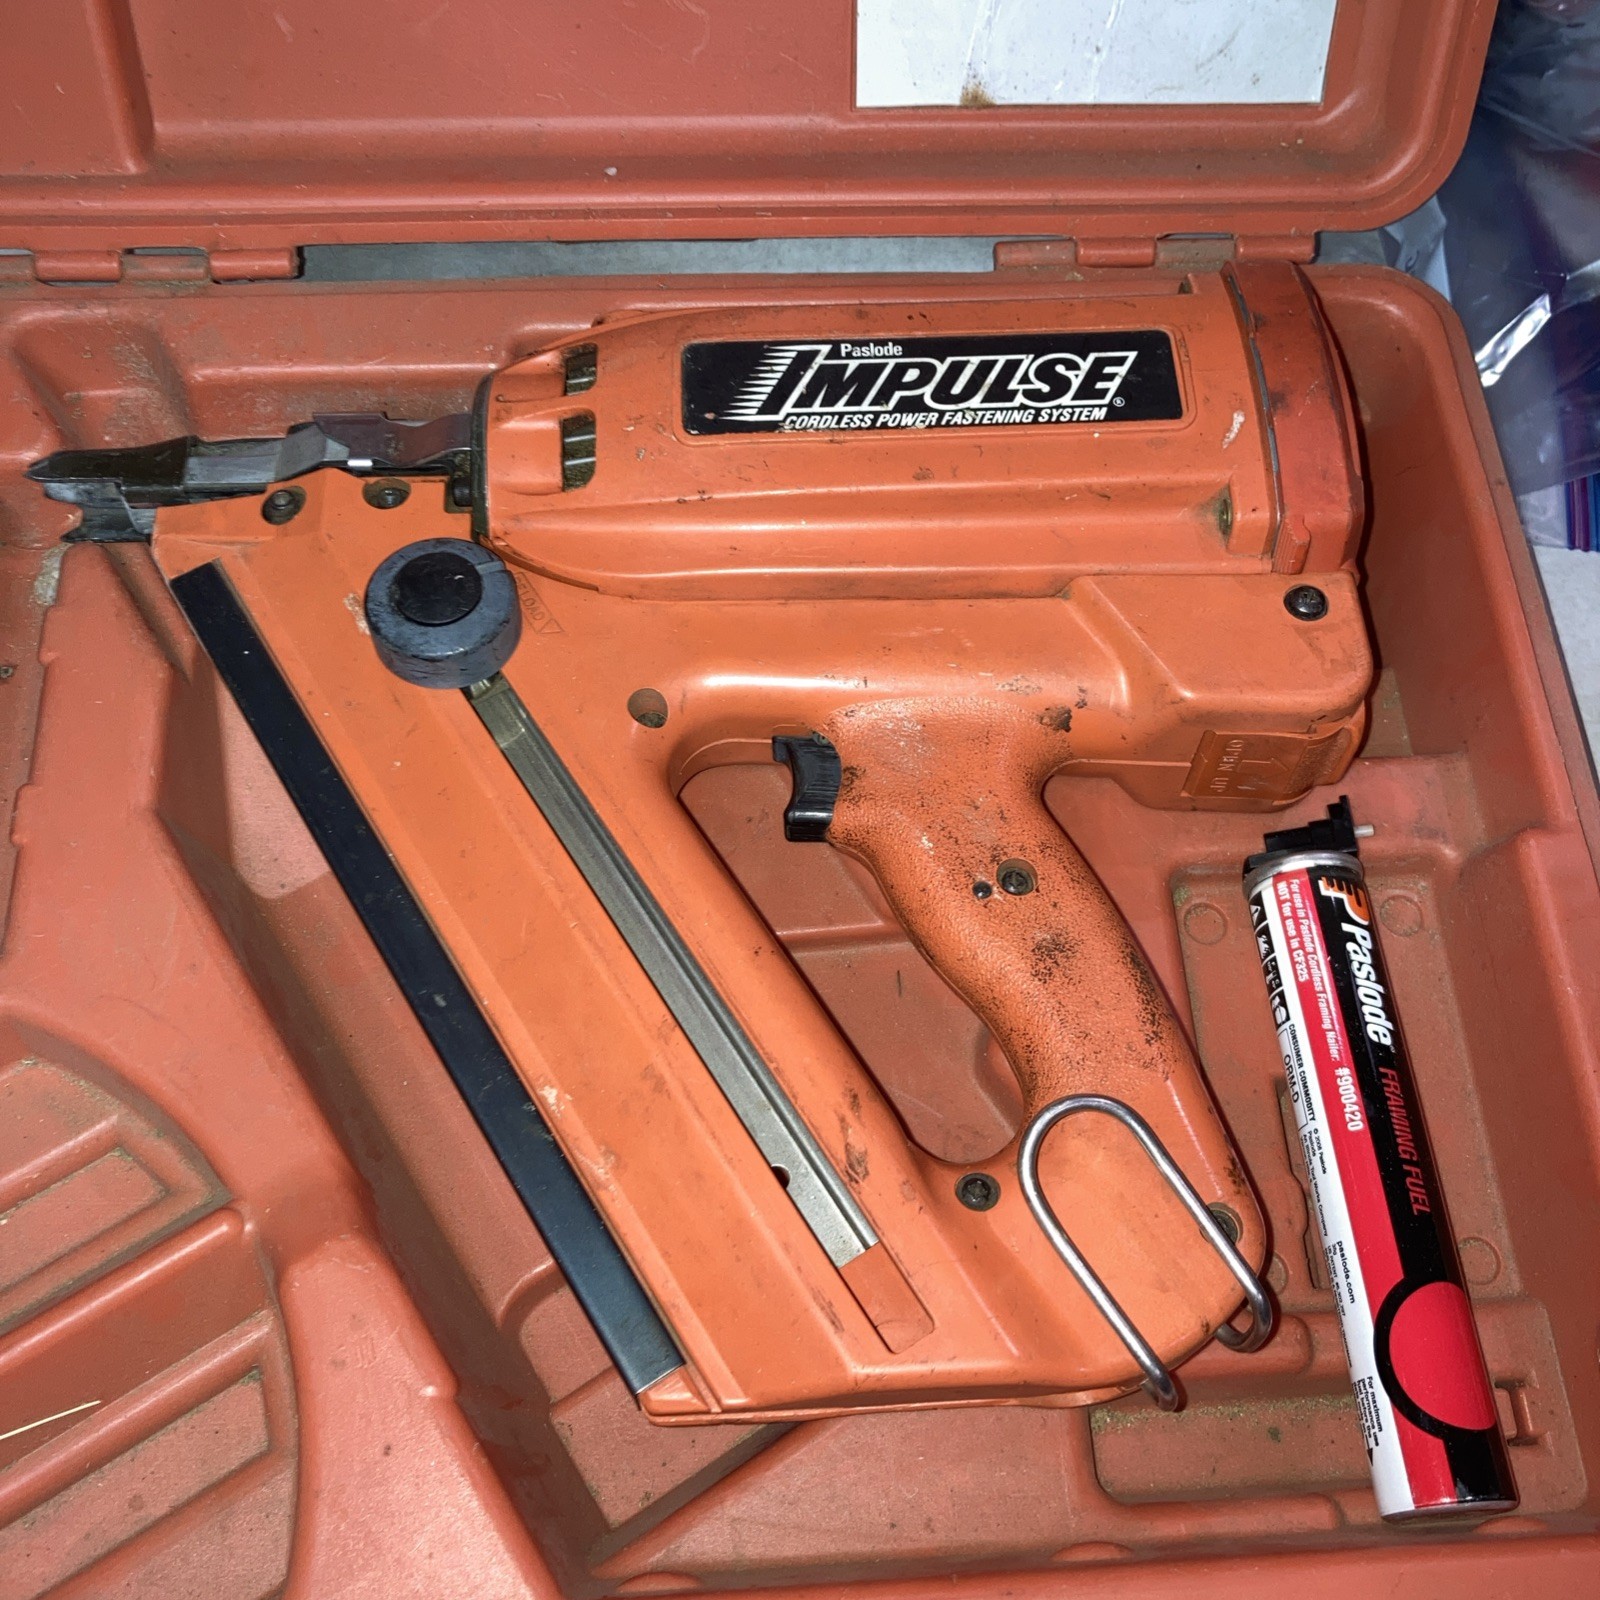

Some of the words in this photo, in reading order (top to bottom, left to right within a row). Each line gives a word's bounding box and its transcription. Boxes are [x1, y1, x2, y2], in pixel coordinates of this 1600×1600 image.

[840, 341, 903, 358] Paslode
[720, 344, 1139, 420] IMPULSE
[785, 415, 874, 431] CORDLESS
[876, 413, 938, 428] POWER
[940, 409, 1033, 426] FASTENING
[1037, 407, 1108, 423] SYSTEM
[1276, 881, 1289, 901] NOT
[1290, 879, 1301, 892] For
[1293, 892, 1304, 908] use
[1281, 901, 1293, 917] for
[1285, 918, 1296, 936] use
[1296, 908, 1307, 918] in
[1289, 938, 1300, 949] in
[1300, 918, 1315, 953] Paslode
[1293, 949, 1307, 982] CF325
[1308, 953, 1324, 991] Cordless
[1340, 922, 1395, 1047] Paslode
[1315, 993, 1332, 1030] Framing
[1282, 1054, 1301, 1104] ORM-D
[1288, 1023, 1304, 1068] CONSUMER
[1299, 1070, 1316, 1122] COMMODITY
[1334, 1066, 1364, 1132] #900420
[1379, 1067, 1418, 1162] FRAMING
[1403, 1164, 1431, 1216] FUEL
[1337, 1240, 1356, 1303] paslode.com
[1360, 1378, 1376, 1429] performance
[1370, 1391, 1383, 1432] maximum
